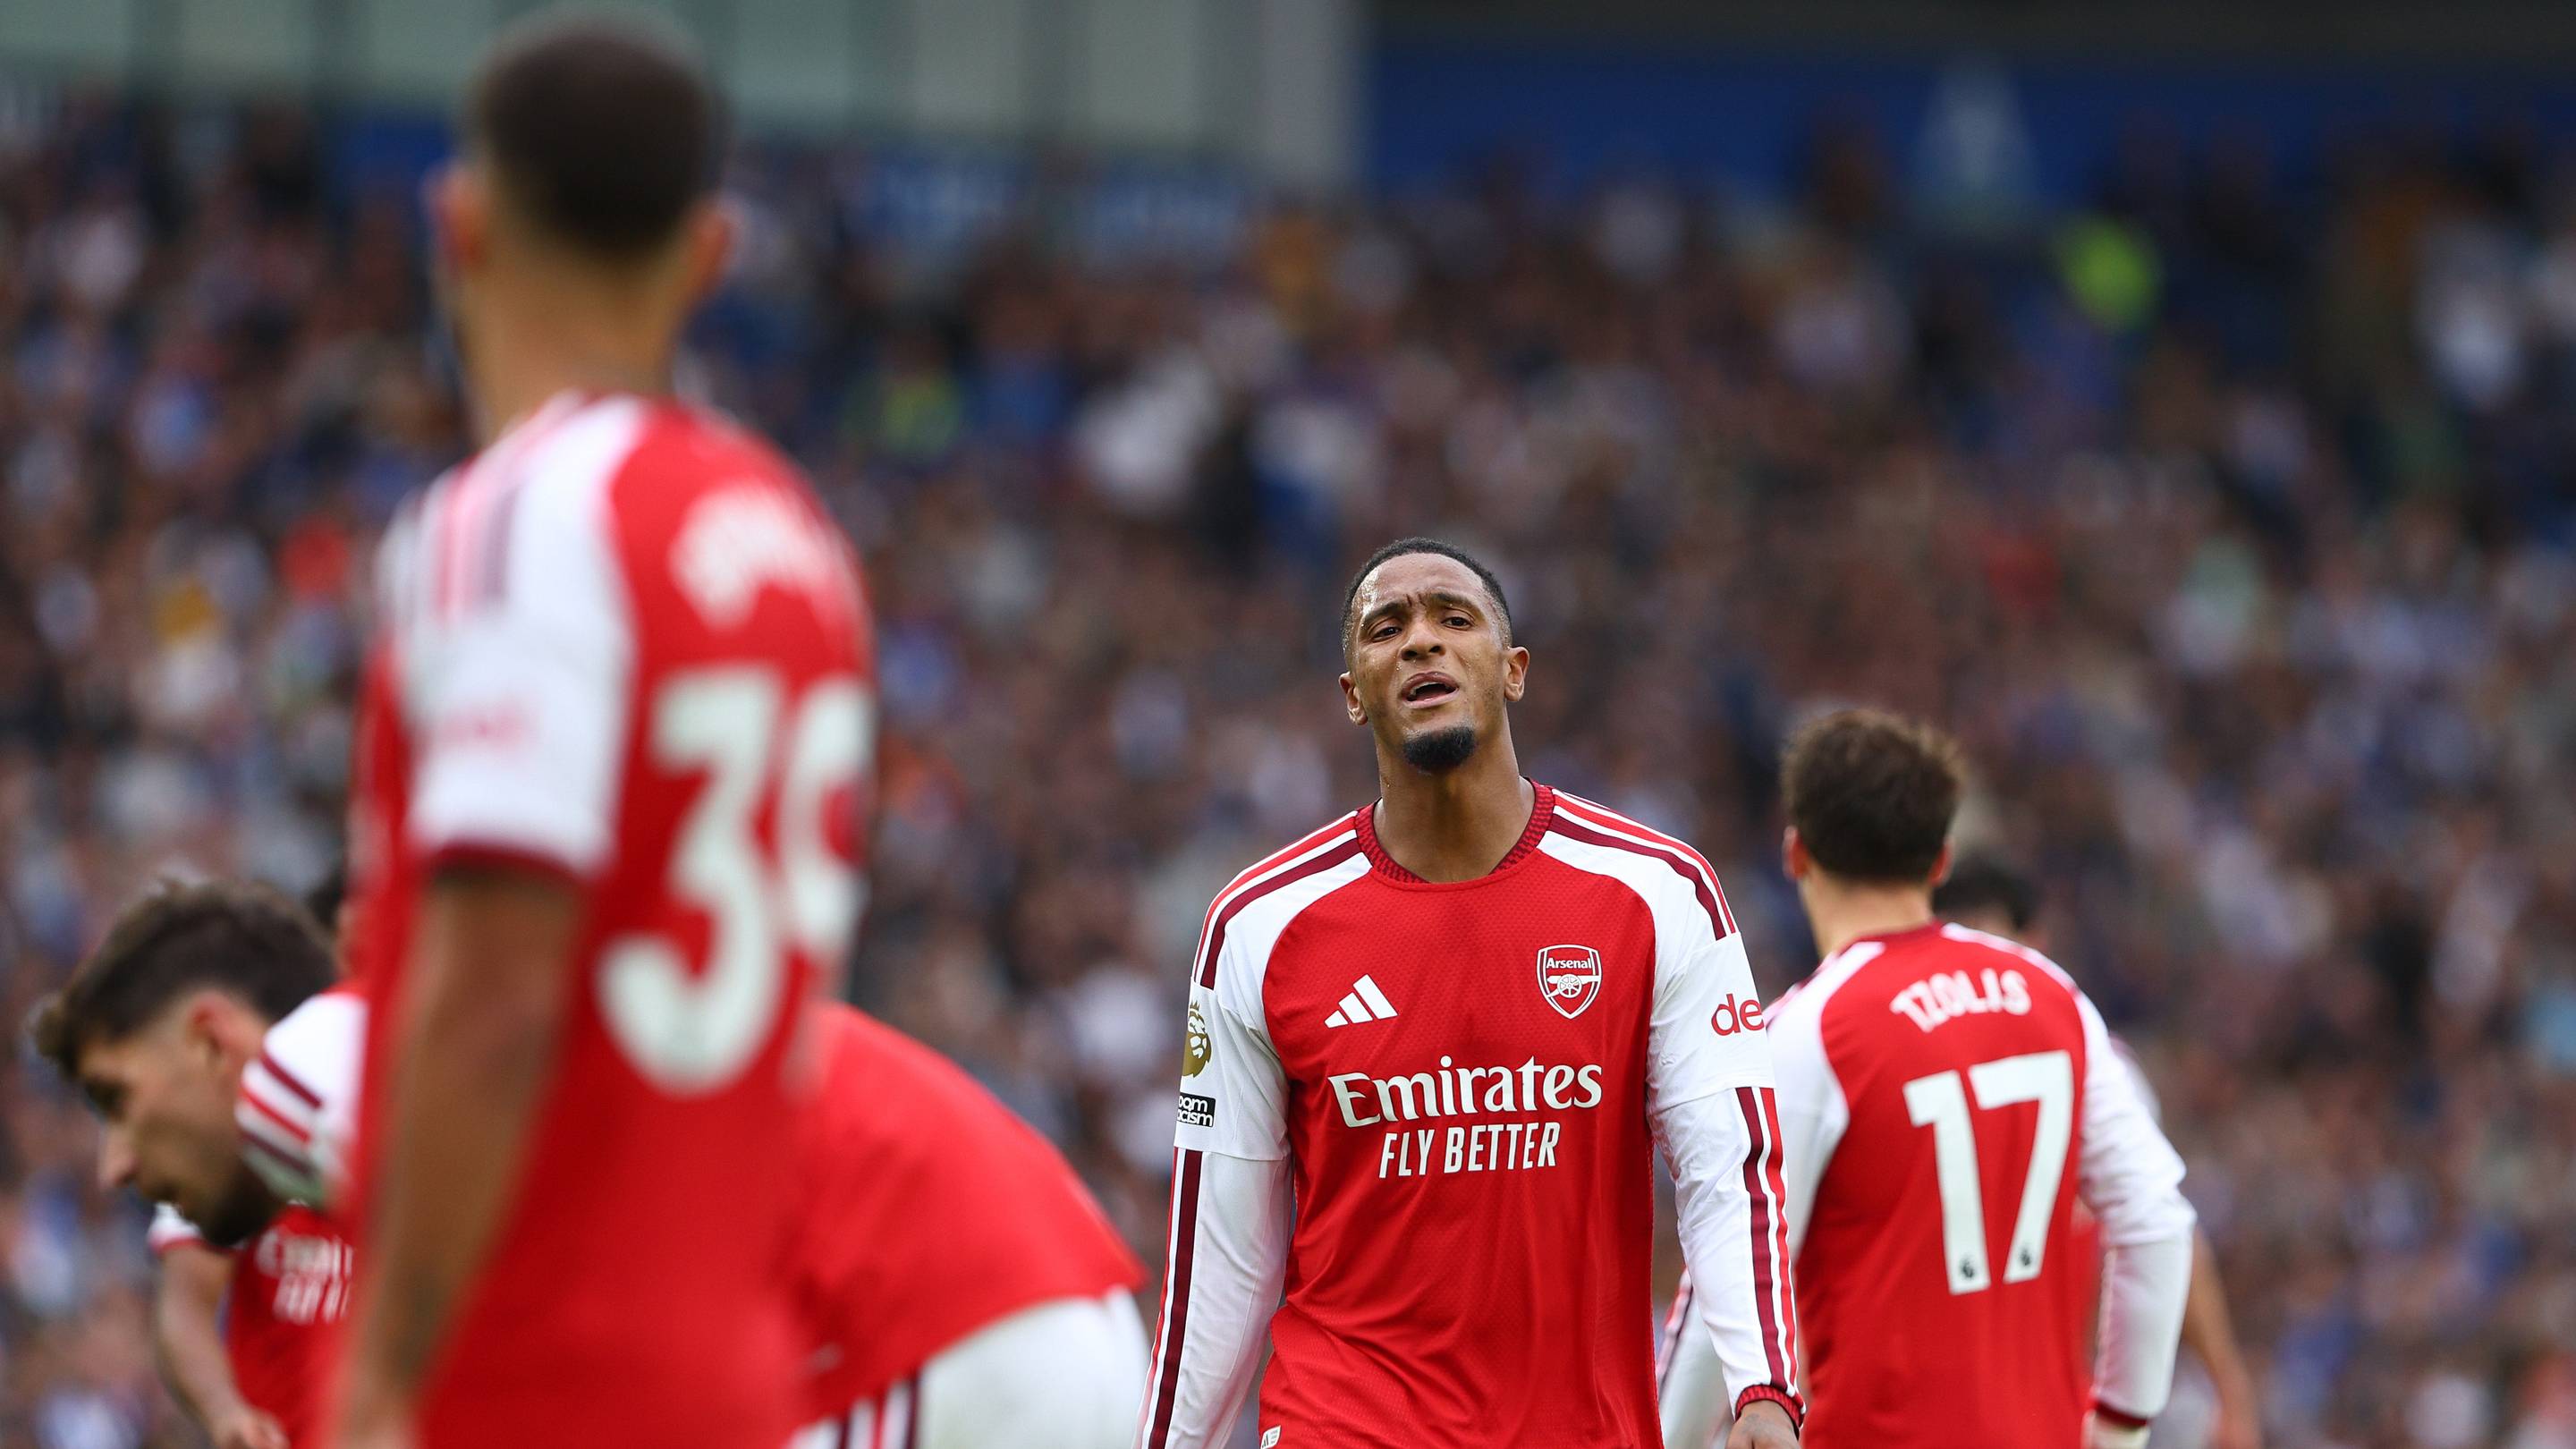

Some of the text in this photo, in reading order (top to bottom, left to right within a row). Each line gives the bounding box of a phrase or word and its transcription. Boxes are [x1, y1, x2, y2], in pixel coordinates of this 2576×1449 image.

[1546, 957, 1592, 970] Arsenal
[1327, 1055, 1603, 1129] Emirates
[1378, 1122, 1561, 1179] FLY BETTER
[1902, 1049, 2075, 1296] 17
